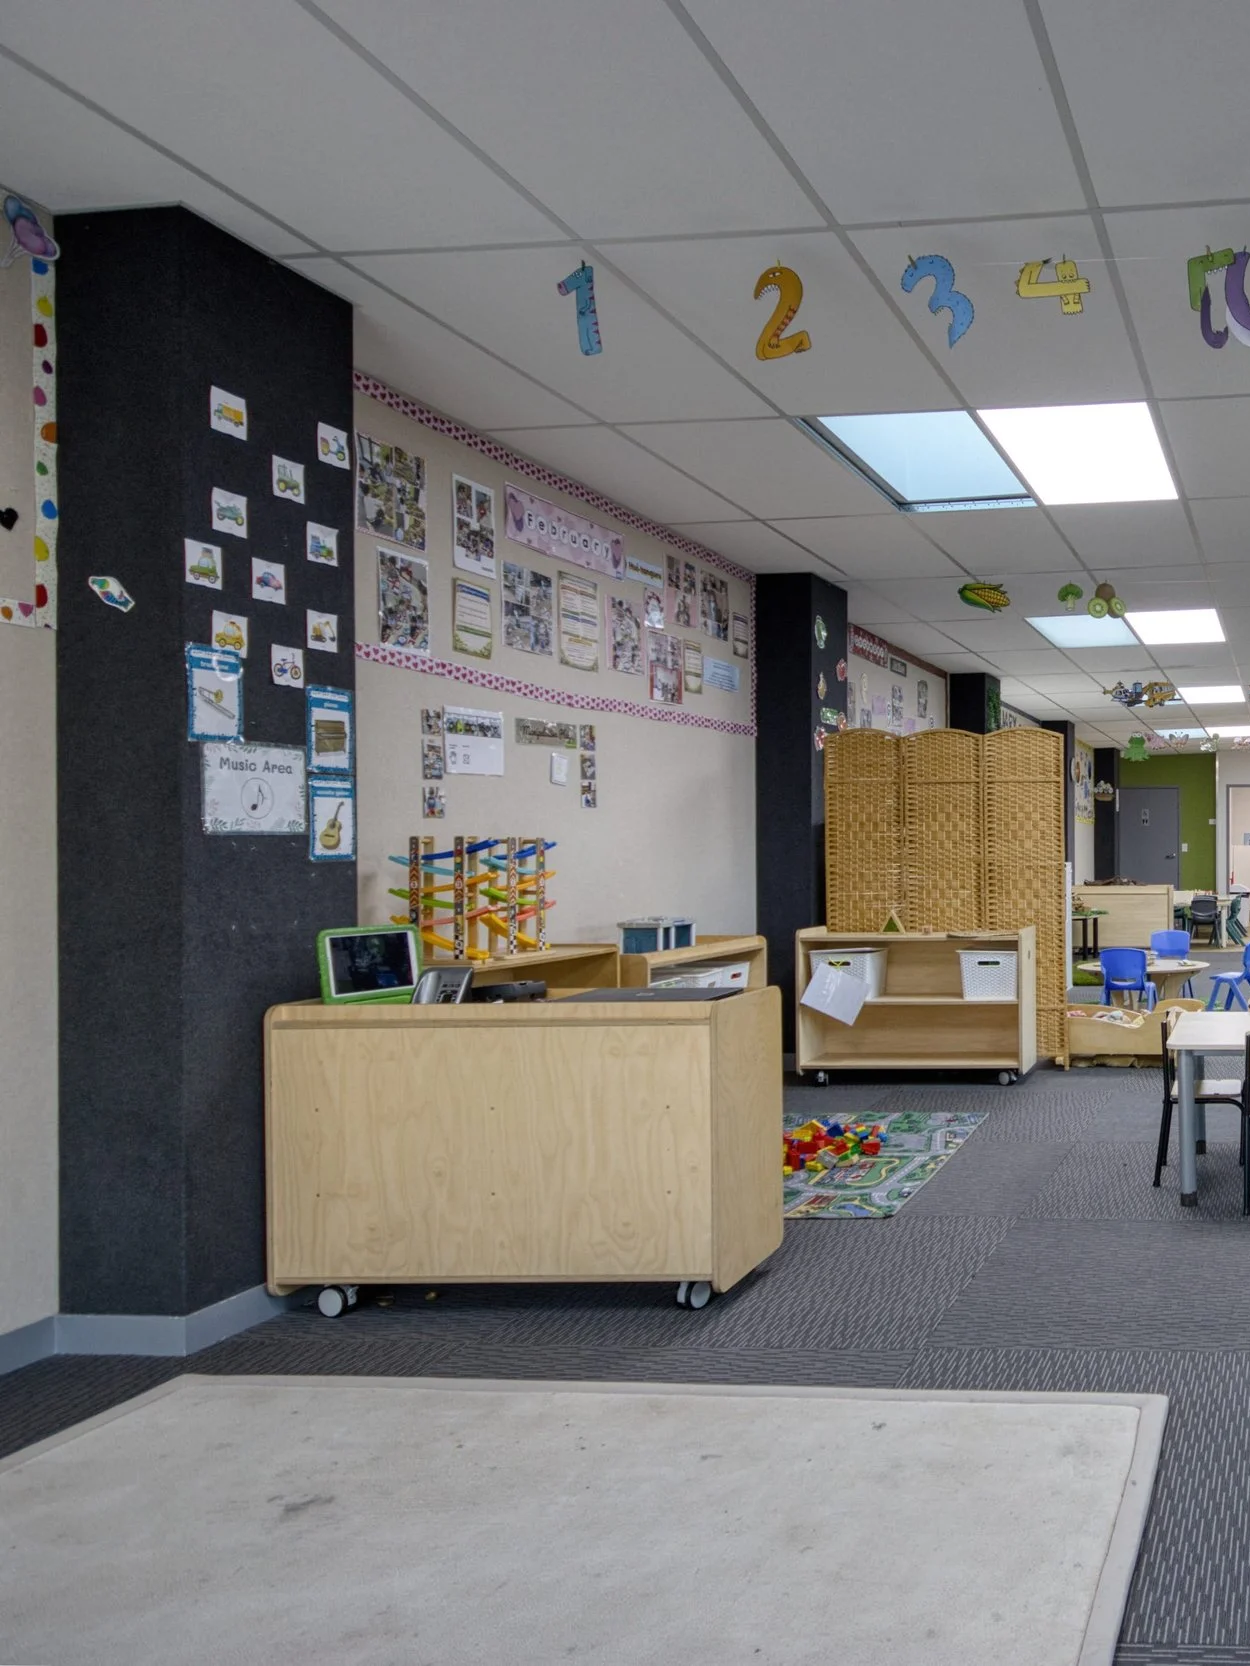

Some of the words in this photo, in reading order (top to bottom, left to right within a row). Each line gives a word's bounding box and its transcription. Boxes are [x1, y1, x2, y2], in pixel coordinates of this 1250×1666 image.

[556, 265, 603, 356] 1
[754, 266, 812, 361] 2
[901, 254, 975, 349] 3
[1016, 259, 1092, 316] 4
[526, 511, 610, 560] February
[219, 756, 257, 772] Music
[262, 761, 293, 775] Area
